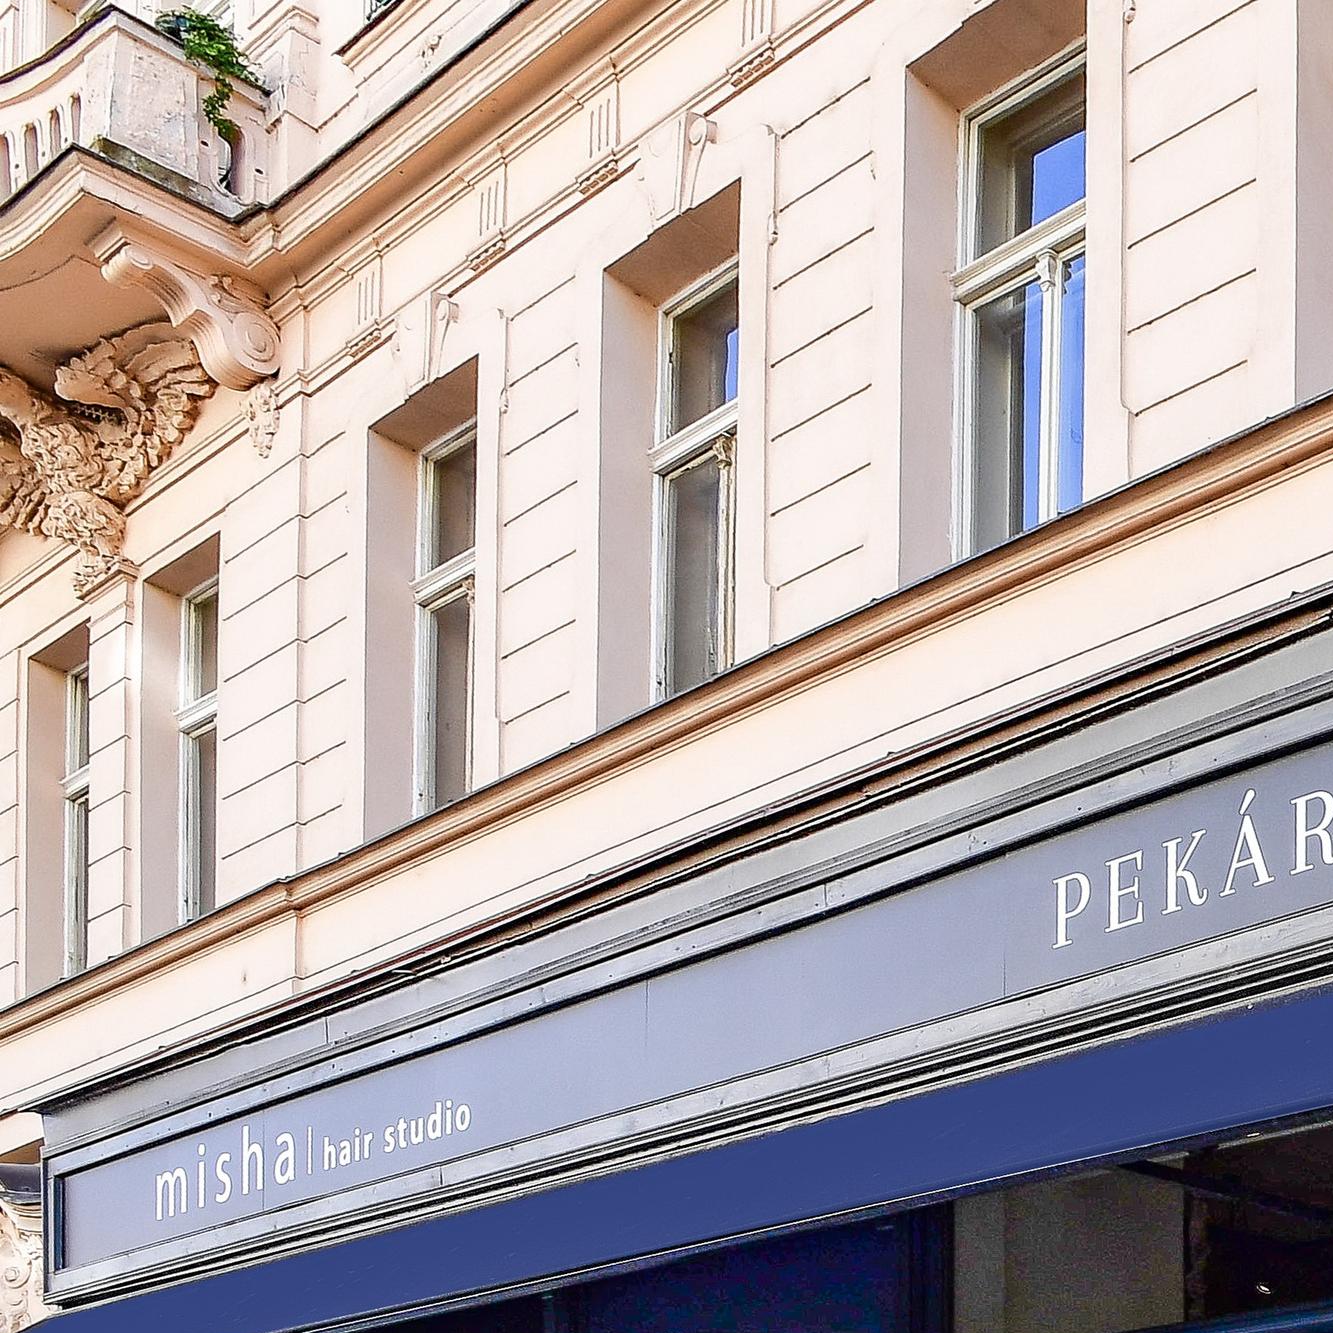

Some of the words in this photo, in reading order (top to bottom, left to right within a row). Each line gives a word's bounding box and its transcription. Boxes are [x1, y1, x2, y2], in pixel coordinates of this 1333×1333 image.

[155, 1125, 296, 1220] misha
[322, 1129, 374, 1170] hair
[384, 1100, 472, 1152] studio
